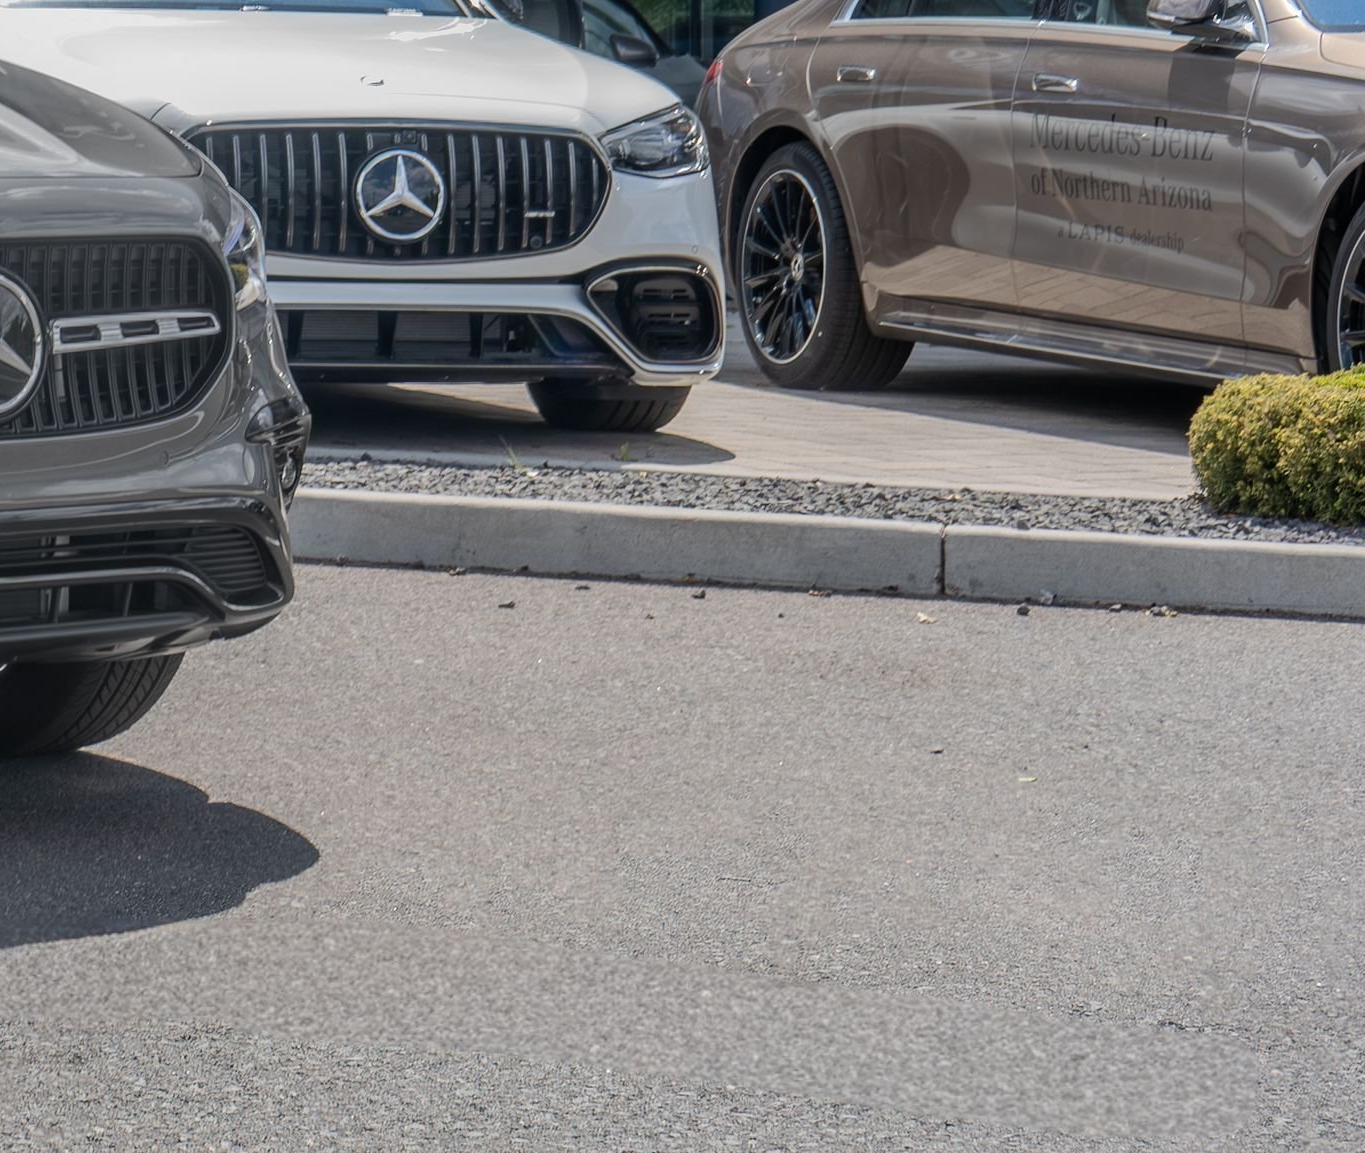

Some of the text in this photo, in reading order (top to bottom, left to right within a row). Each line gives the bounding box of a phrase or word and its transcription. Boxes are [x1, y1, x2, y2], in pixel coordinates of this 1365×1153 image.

[1030, 112, 1214, 161] Mercedes-Benz
[1031, 167, 1212, 211] of Northern Arizona
[1068, 219, 1124, 244] LAPIS
[1129, 227, 1185, 253] dealership
